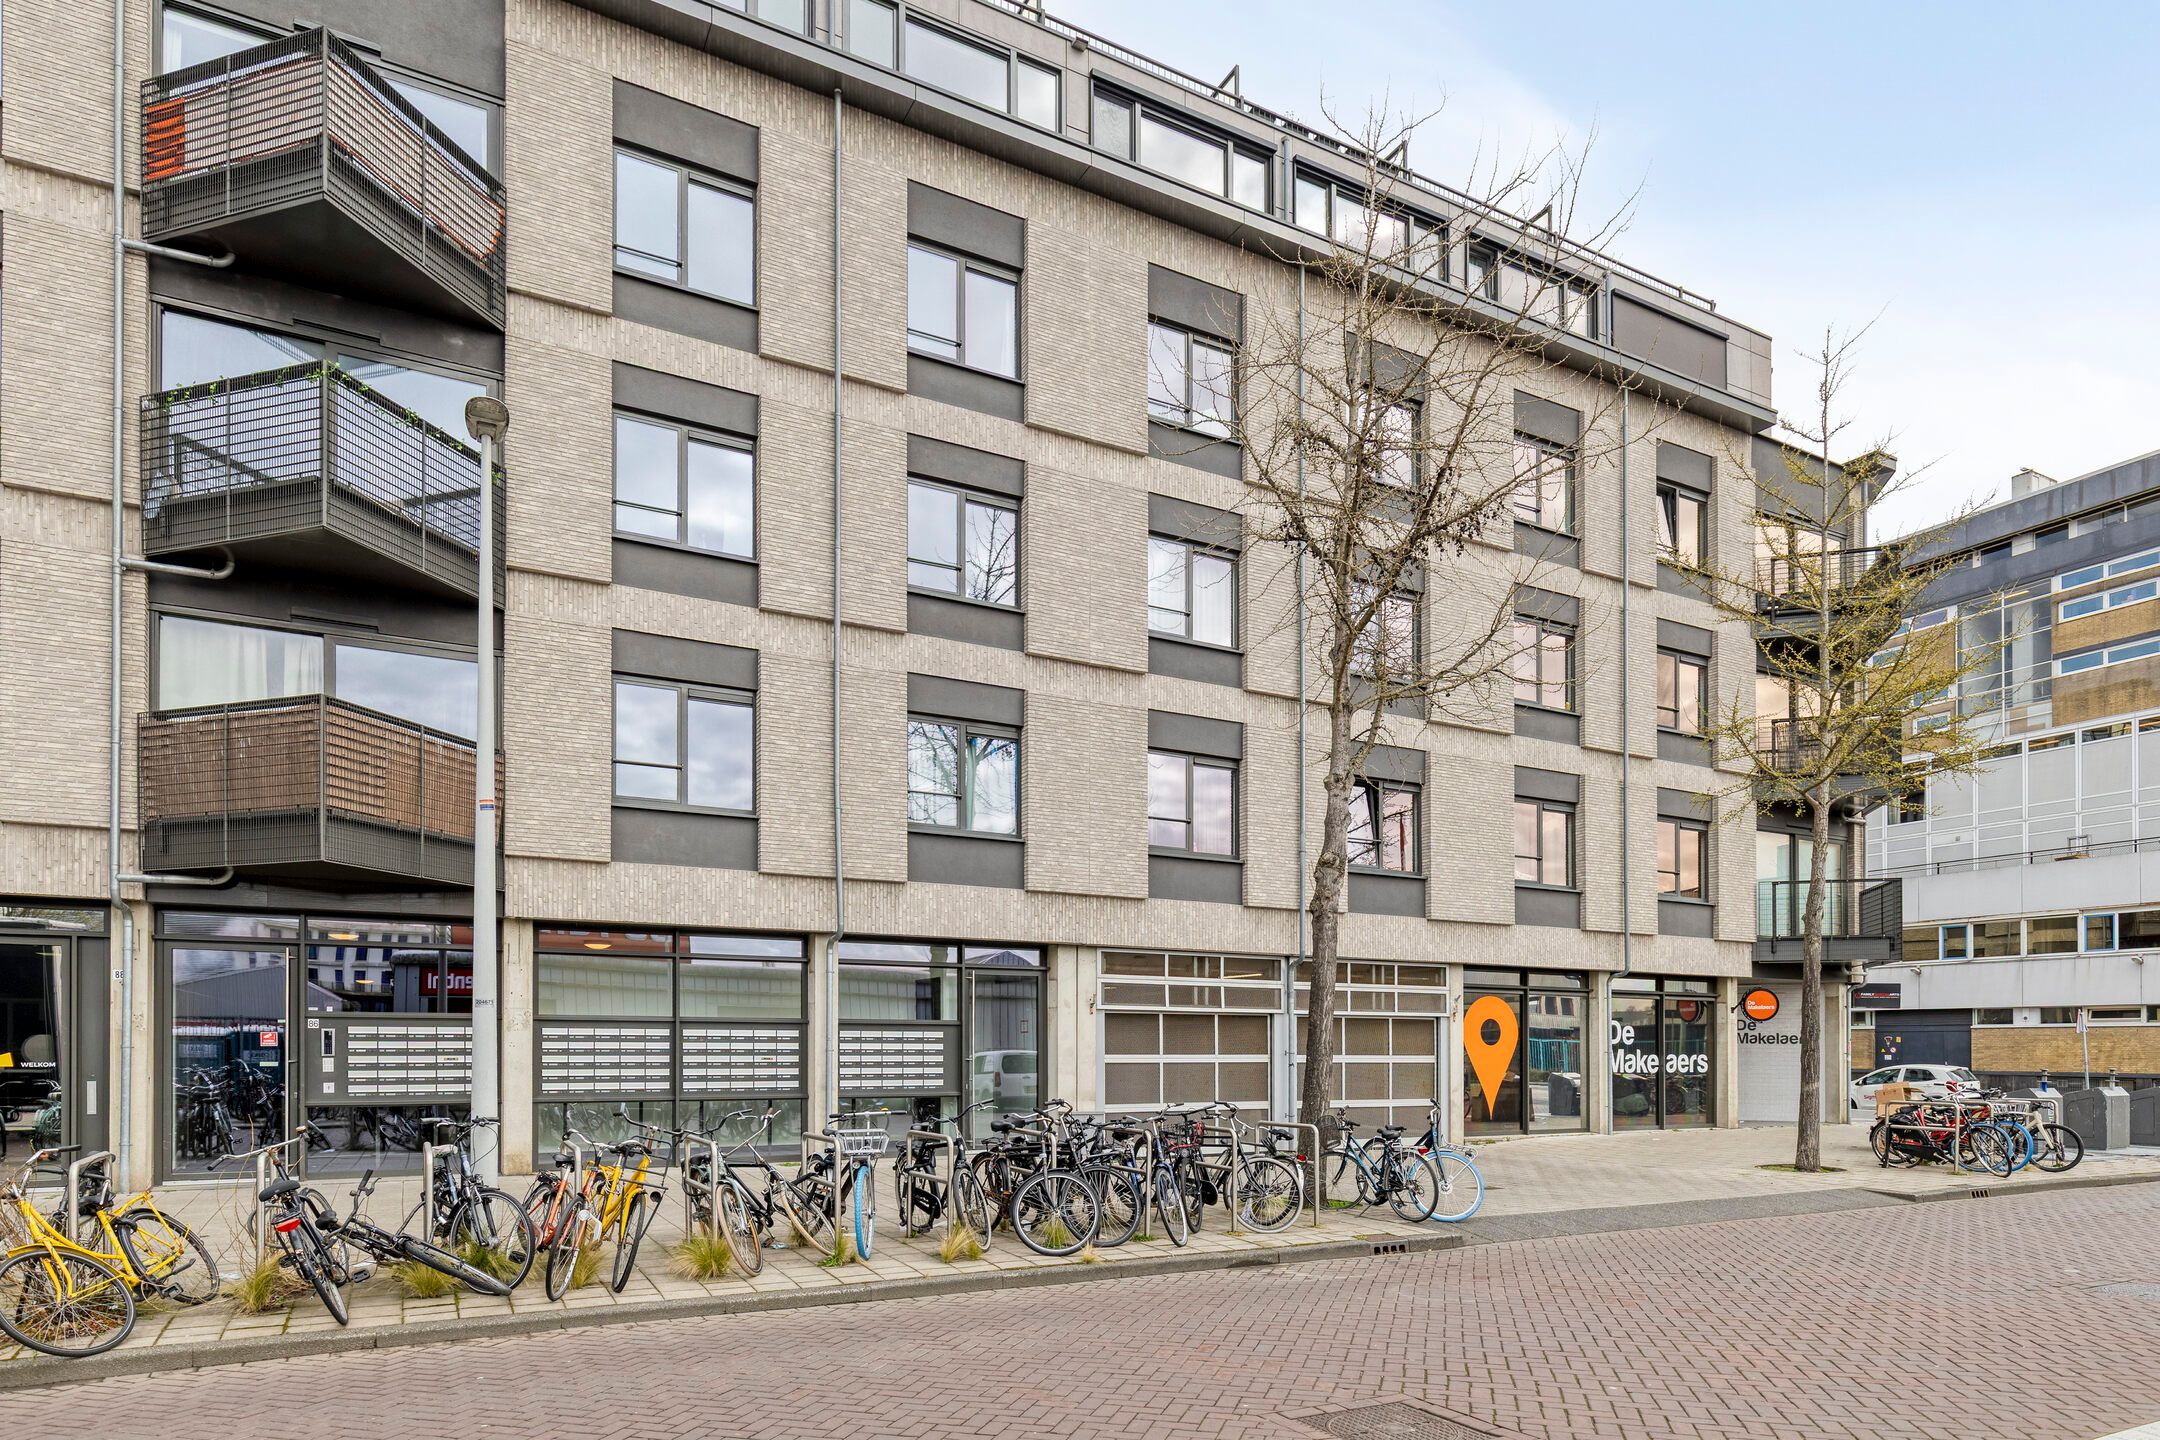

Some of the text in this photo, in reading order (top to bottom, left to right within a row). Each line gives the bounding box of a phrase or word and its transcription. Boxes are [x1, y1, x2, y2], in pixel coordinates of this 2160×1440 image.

[1611, 1020, 1635, 1045] De
[1737, 1020, 1756, 1031] De
[1737, 1032, 1802, 1045] Makelae
[1611, 1049, 1709, 1074] Makeaers
